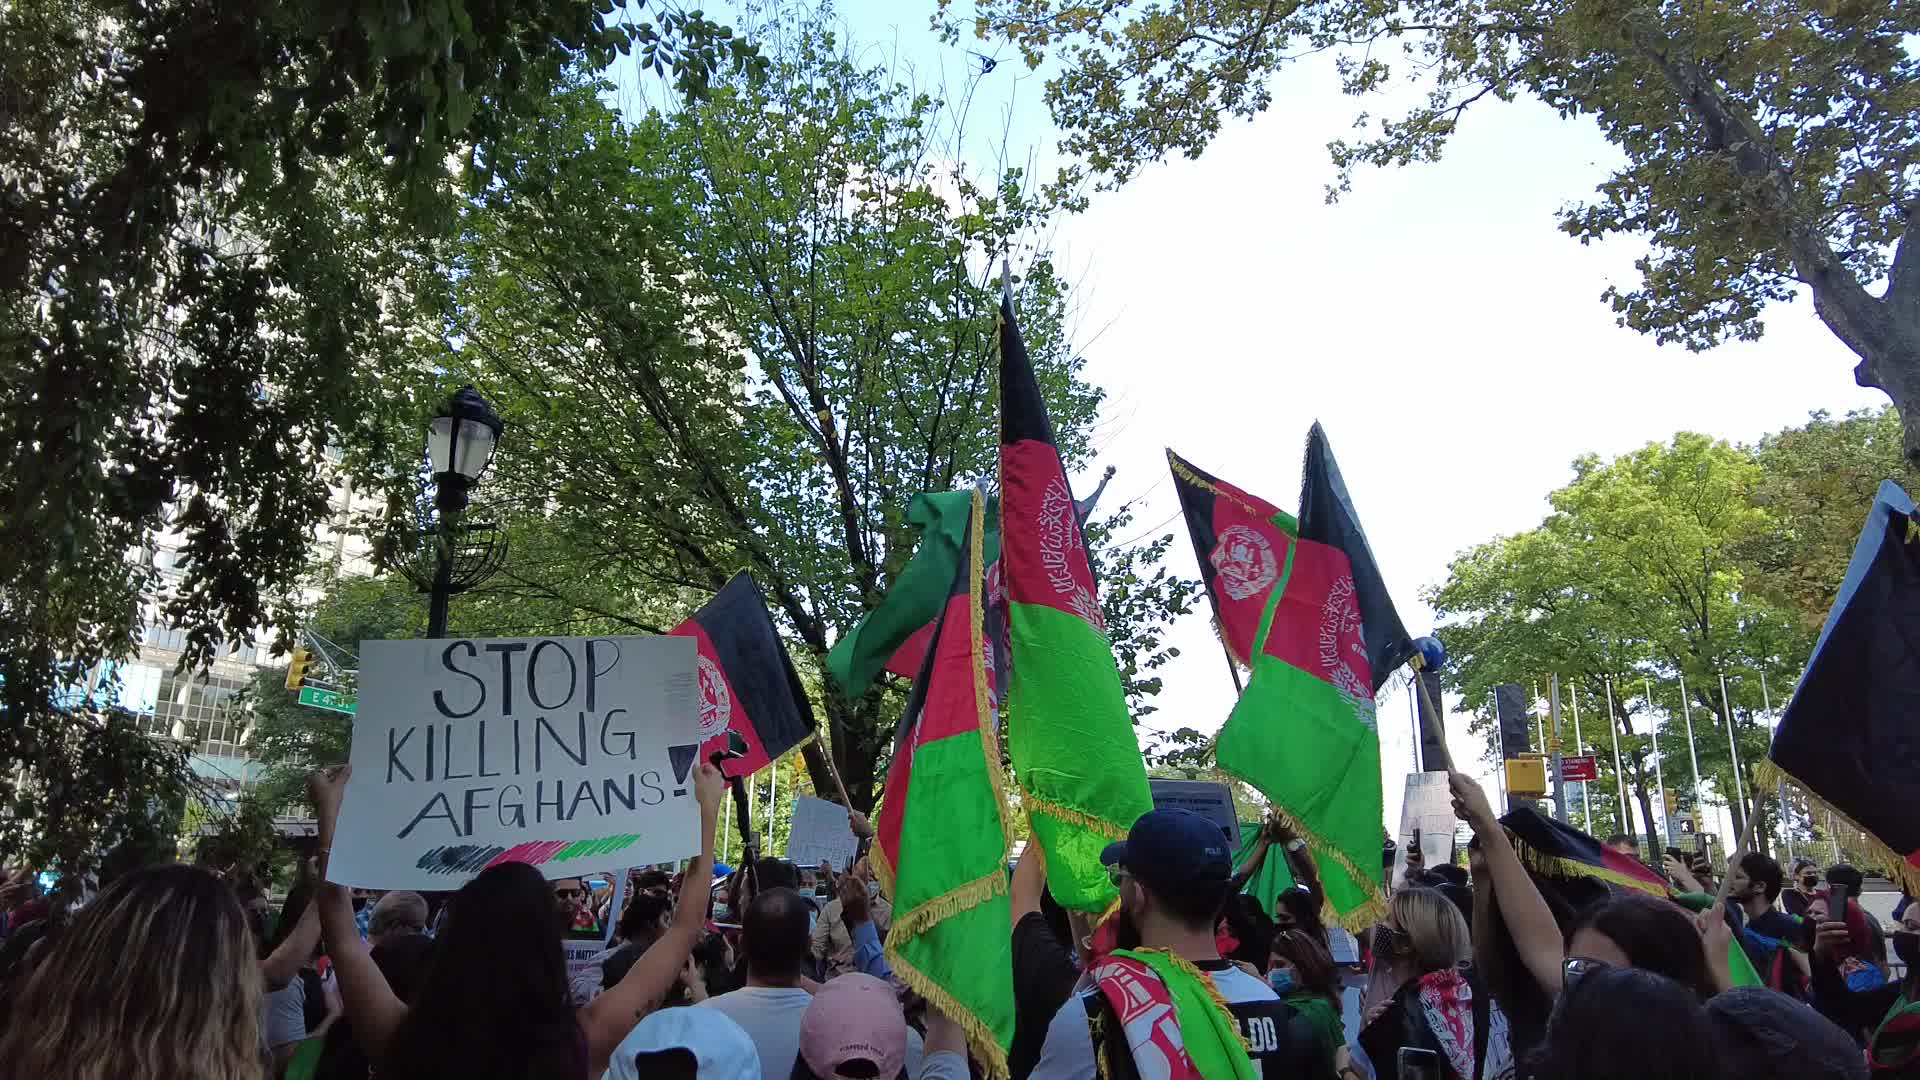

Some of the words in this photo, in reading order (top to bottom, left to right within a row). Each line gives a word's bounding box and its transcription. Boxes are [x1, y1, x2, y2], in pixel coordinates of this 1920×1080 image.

[312, 691, 320, 703] E
[433, 639, 620, 718] STOP
[386, 709, 637, 783] KILLING
[397, 743, 699, 838] AFGHANS!
